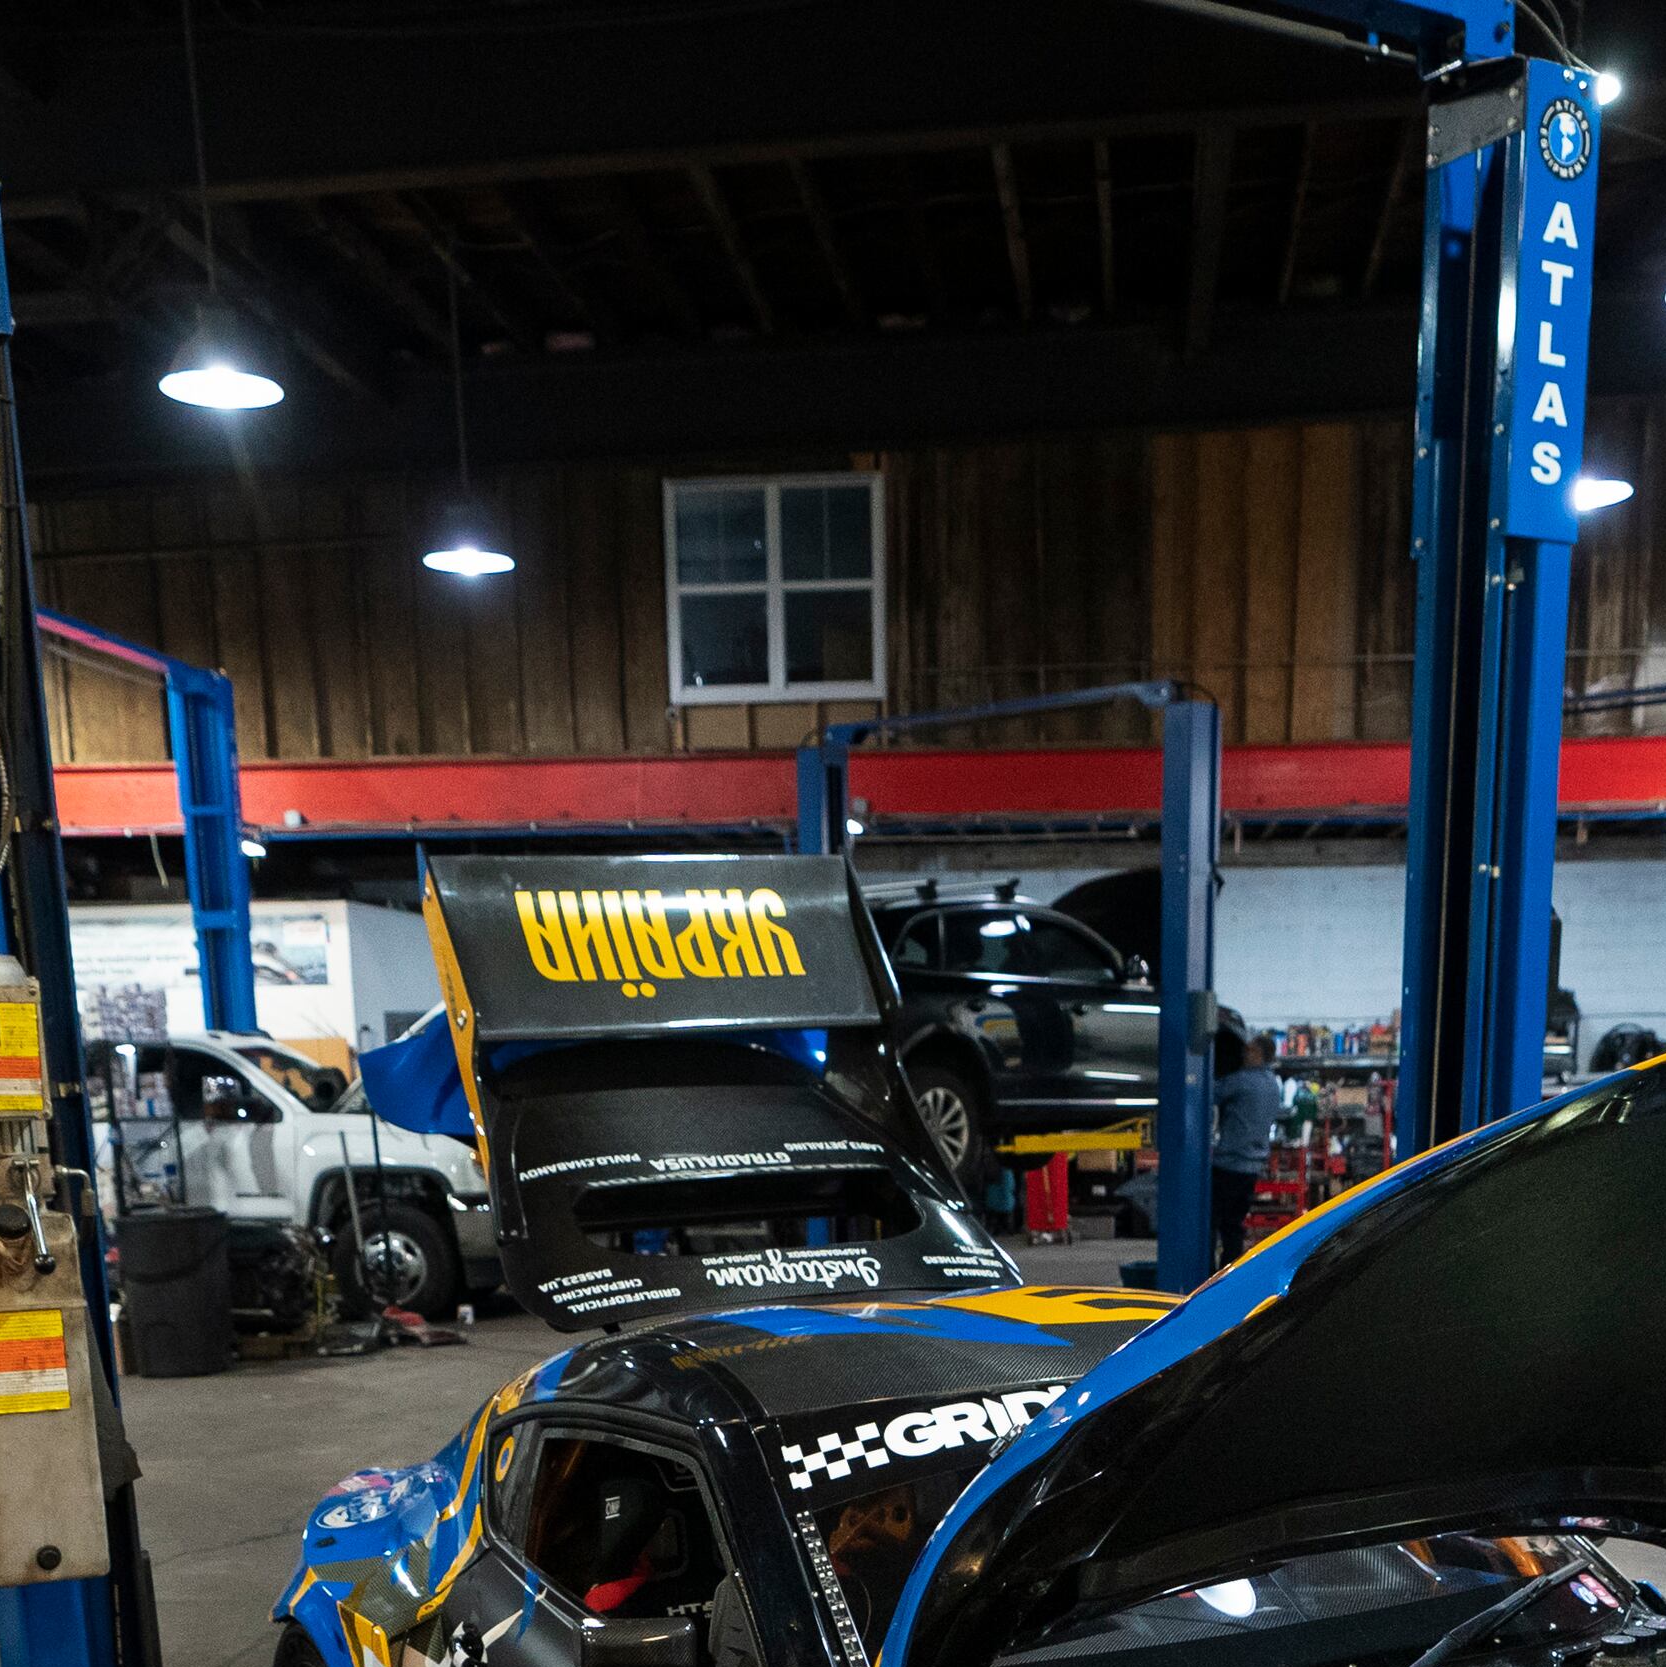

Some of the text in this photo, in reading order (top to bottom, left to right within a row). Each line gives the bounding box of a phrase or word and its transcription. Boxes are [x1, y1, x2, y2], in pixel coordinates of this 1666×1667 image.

[1530, 201, 1578, 485] ATLAS
[514, 888, 807, 998] УКРАЇНА
[519, 1153, 642, 1182] PAVLO.CHABANOV
[648, 1151, 791, 1172] GTRADIALUSA
[706, 1249, 881, 1289] Instagram
[552, 1278, 643, 1304] CHEPARACING
[567, 1287, 681, 1314] GRIDLIFEOFFICIAL
[883, 1385, 1066, 1456] GRID
